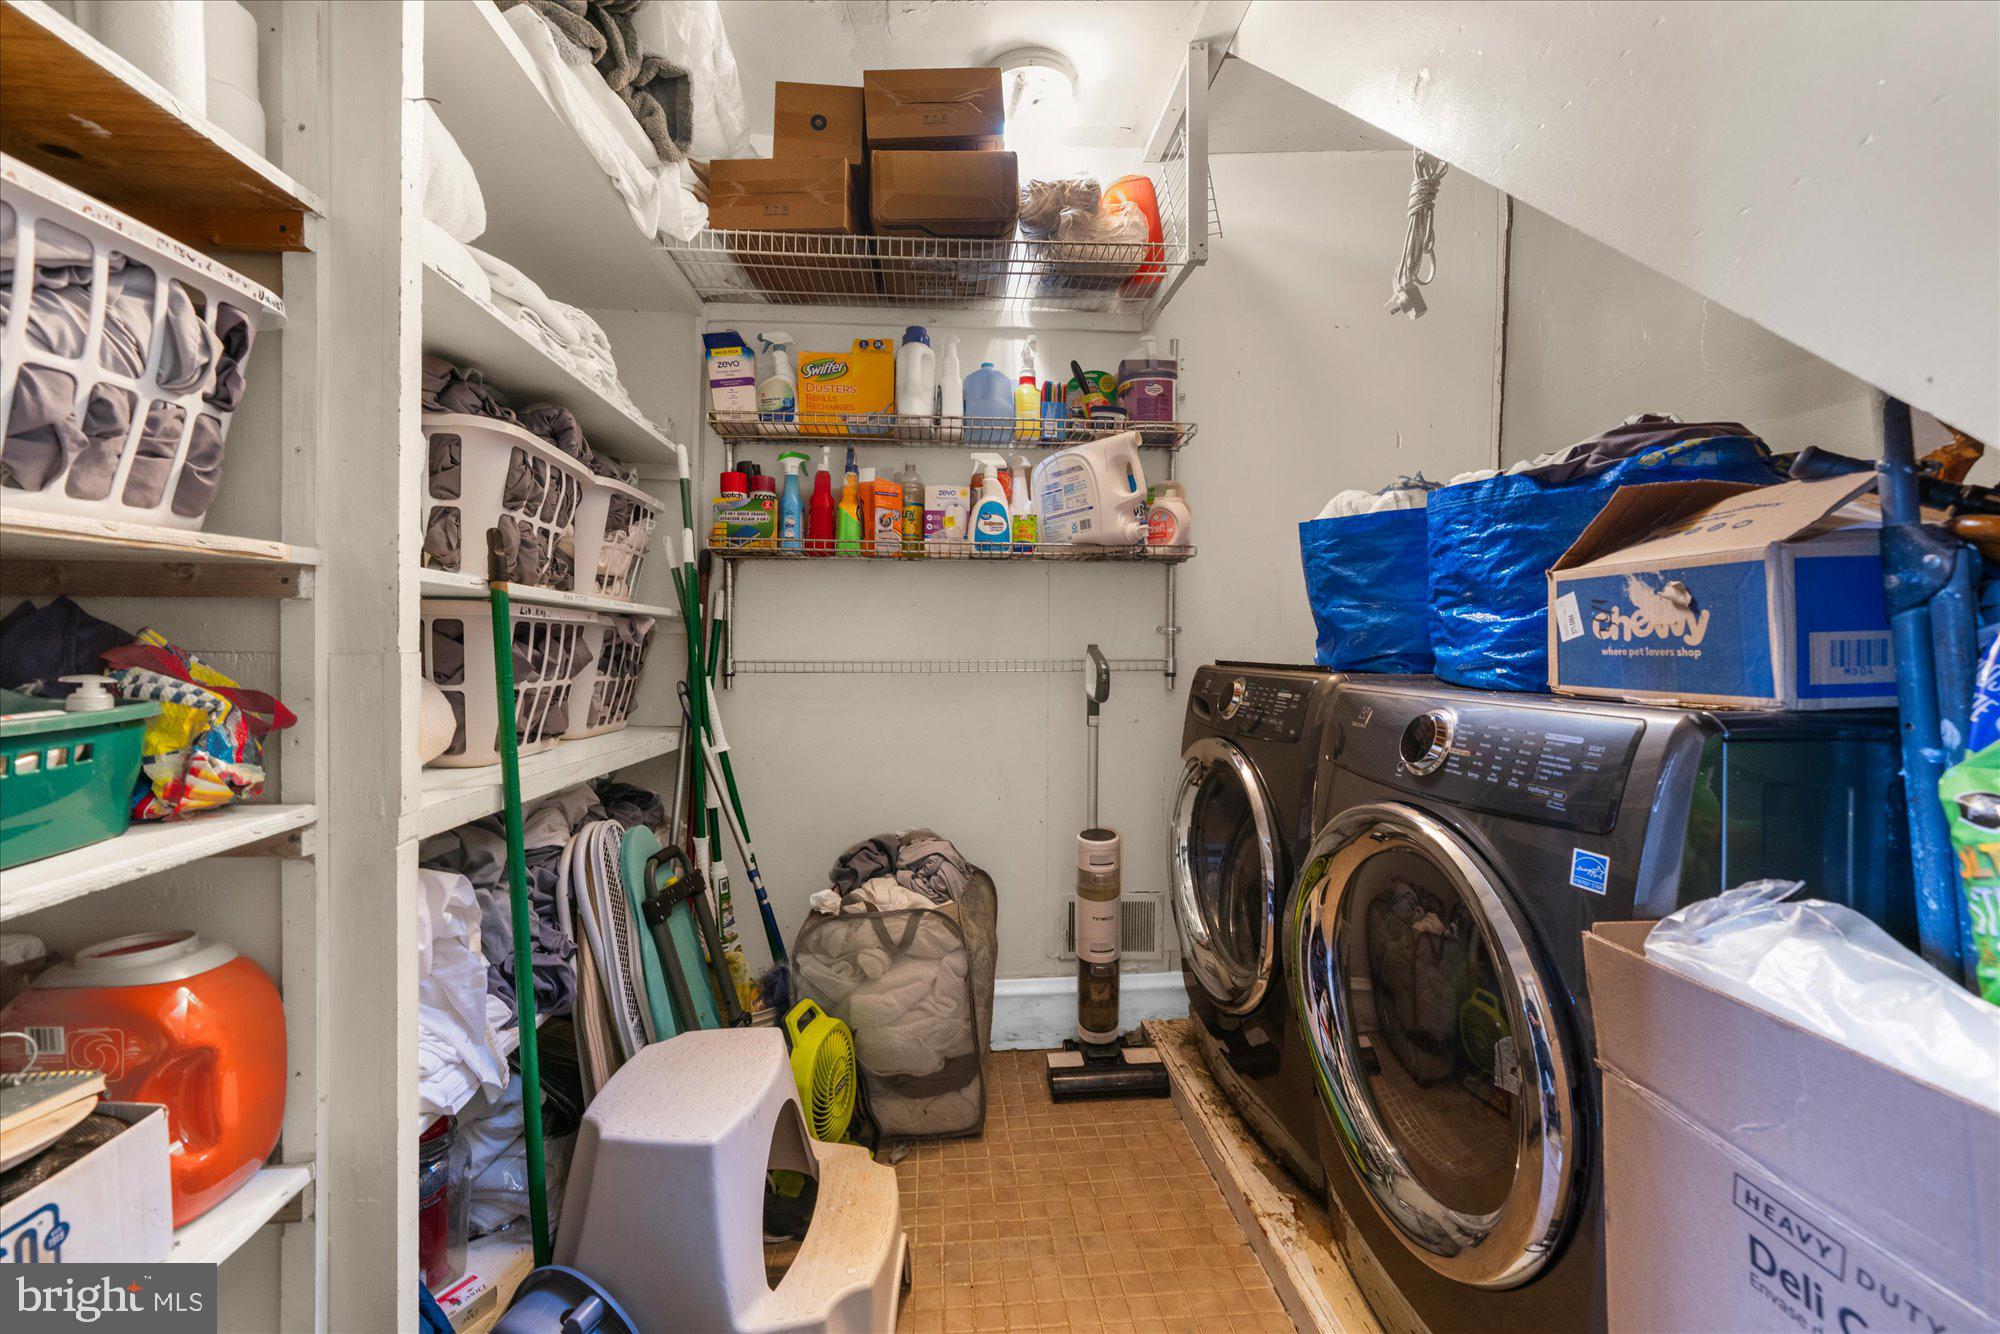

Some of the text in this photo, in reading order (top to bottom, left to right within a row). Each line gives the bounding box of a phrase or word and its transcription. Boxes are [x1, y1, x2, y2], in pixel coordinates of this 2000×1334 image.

[717, 360, 740, 368] zevo
[804, 361, 845, 378] Swiffer
[805, 382, 857, 394] DUSTERS
[806, 402, 855, 411] RECHARGES
[1601, 647, 1702, 660] where pet lovers shop
[1744, 1188, 1947, 1334] HEAVY DUTY
[1747, 1232, 1826, 1321] Deli
[1749, 1272, 1808, 1330] Envase
